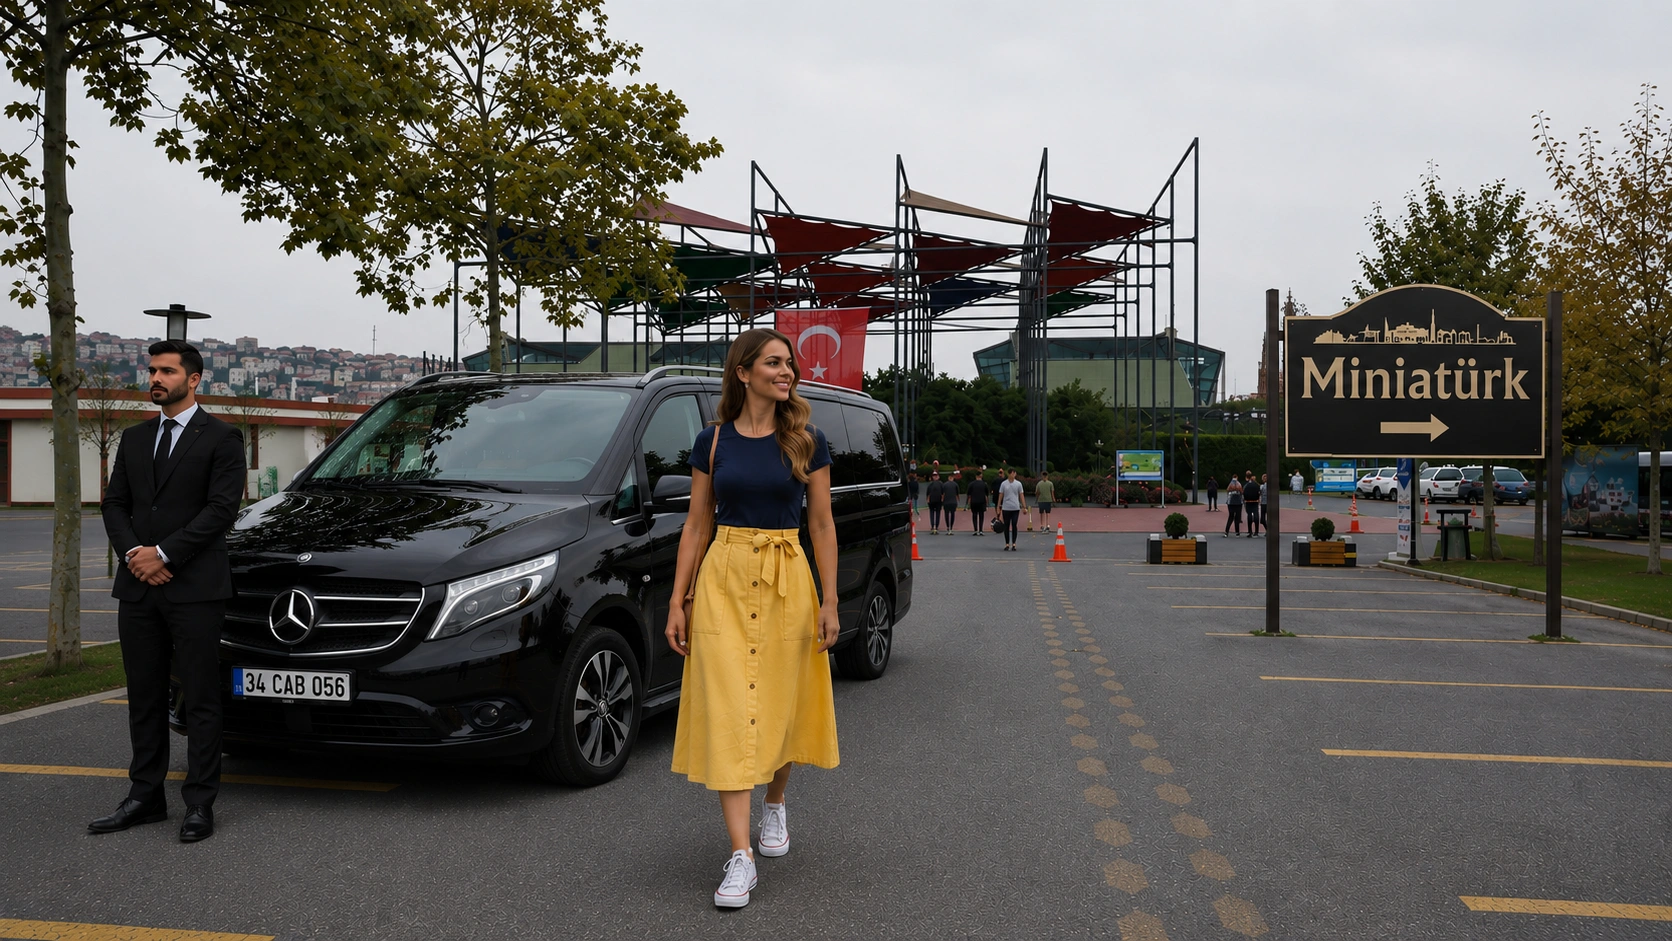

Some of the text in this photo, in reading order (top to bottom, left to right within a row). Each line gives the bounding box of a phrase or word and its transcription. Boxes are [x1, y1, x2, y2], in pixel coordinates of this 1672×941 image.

[1301, 357, 1530, 400] Miniatürk
[245, 672, 345, 698] 34 CAB 056
